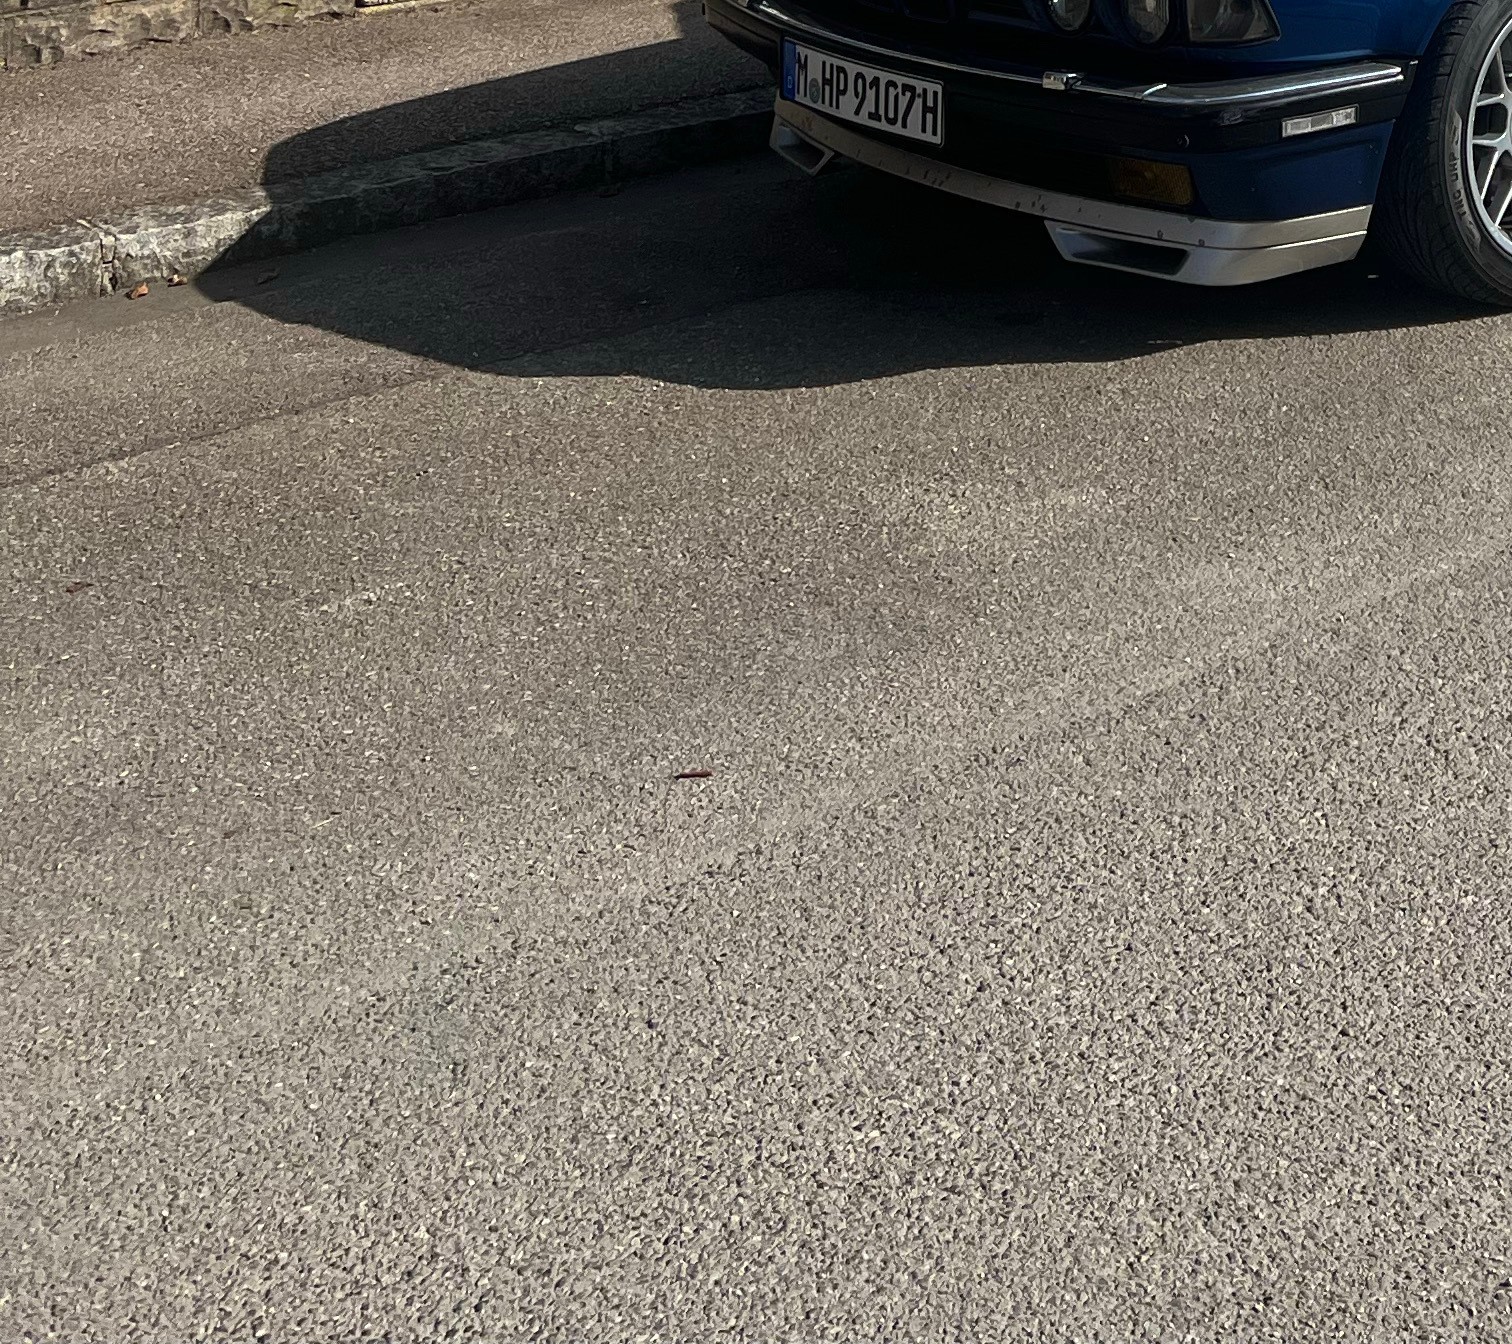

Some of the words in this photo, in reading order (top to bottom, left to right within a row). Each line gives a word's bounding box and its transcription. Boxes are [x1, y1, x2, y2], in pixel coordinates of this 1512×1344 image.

[796, 52, 808, 98] M
[821, 60, 849, 110] HP
[853, 71, 939, 137] 9107H
